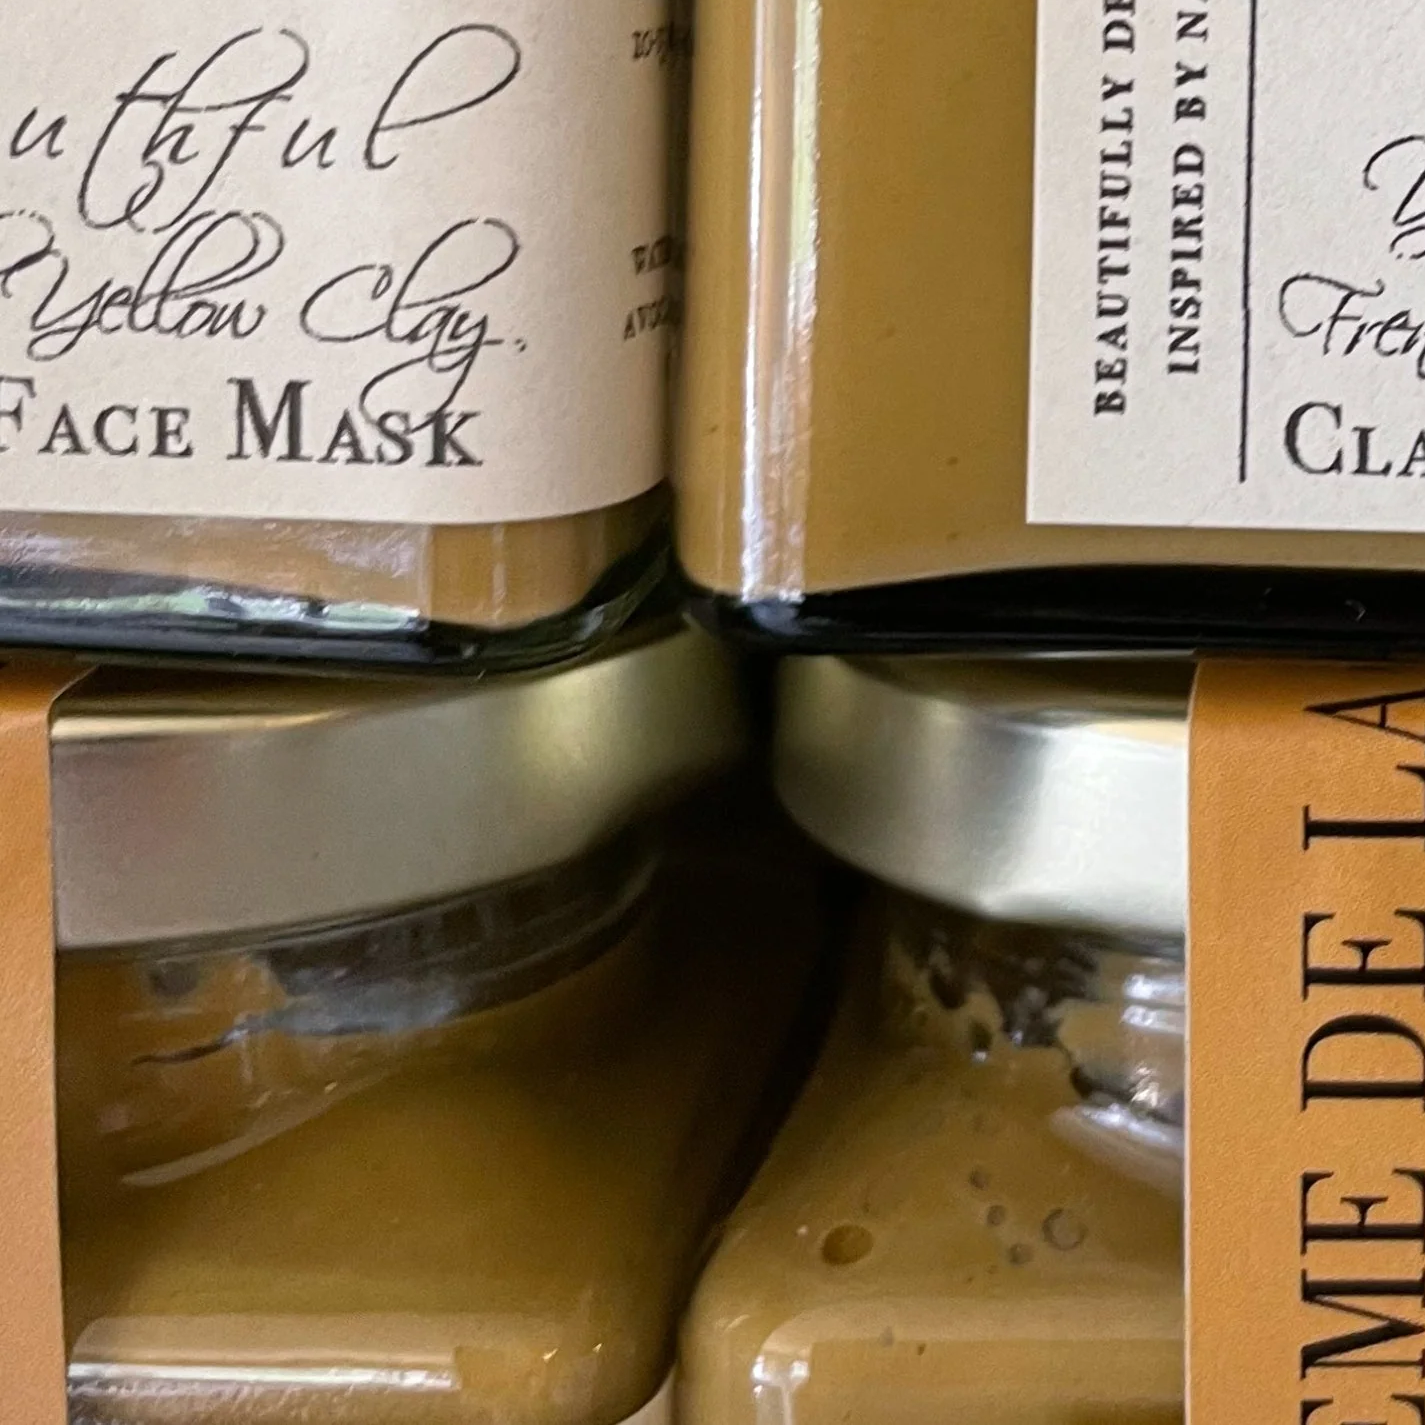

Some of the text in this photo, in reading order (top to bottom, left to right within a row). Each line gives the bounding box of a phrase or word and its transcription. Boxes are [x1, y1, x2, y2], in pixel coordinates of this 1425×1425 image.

[1174, 61, 1210, 123] BY
[2, 209, 286, 362] Yellow
[1093, 74, 1136, 416] BEAUTIFULLY
[1167, 141, 1206, 378] INSPIRED
